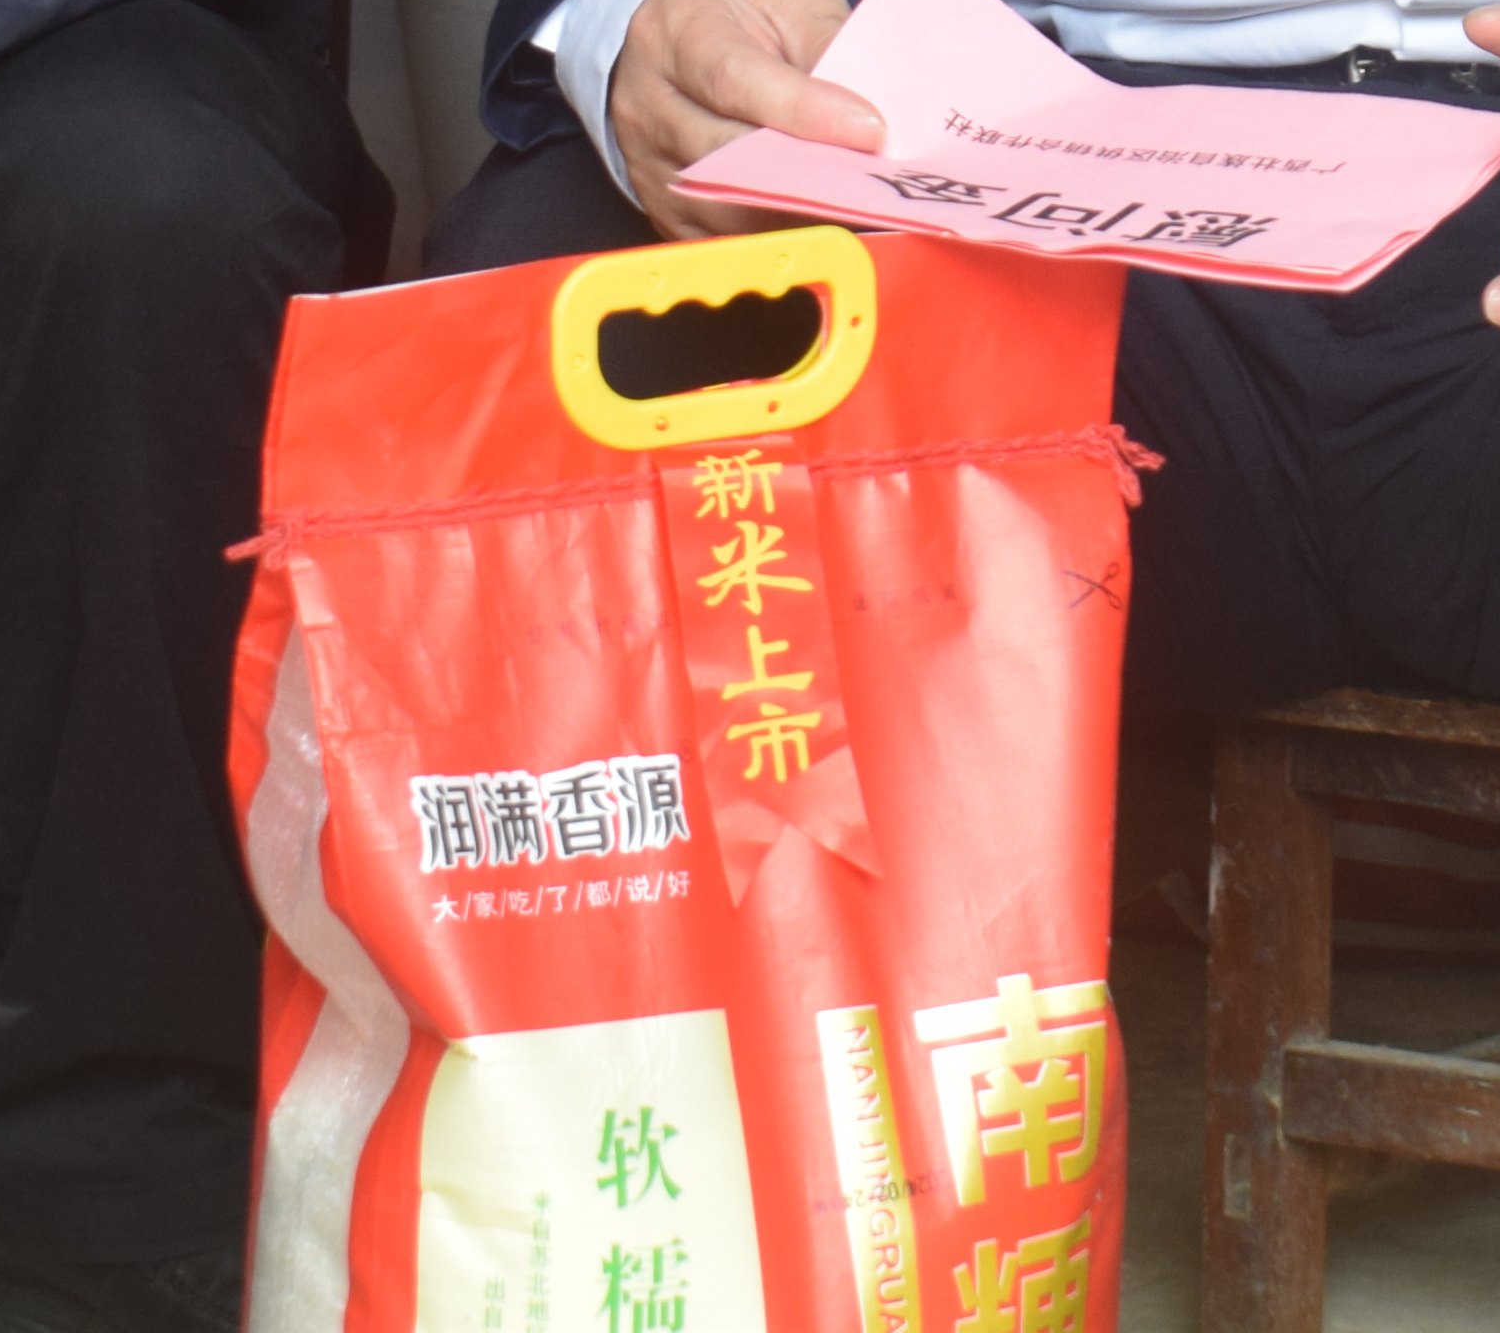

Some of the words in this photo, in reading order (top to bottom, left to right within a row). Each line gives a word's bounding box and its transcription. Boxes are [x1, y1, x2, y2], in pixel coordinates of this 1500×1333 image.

[943, 107, 1348, 175] 广西壮族自治区供销合作联社
[867, 167, 1279, 249] 慰问金
[692, 448, 822, 783] 新米上市
[414, 757, 690, 870] 润满香源
[595, 1105, 690, 1333] 软糯
